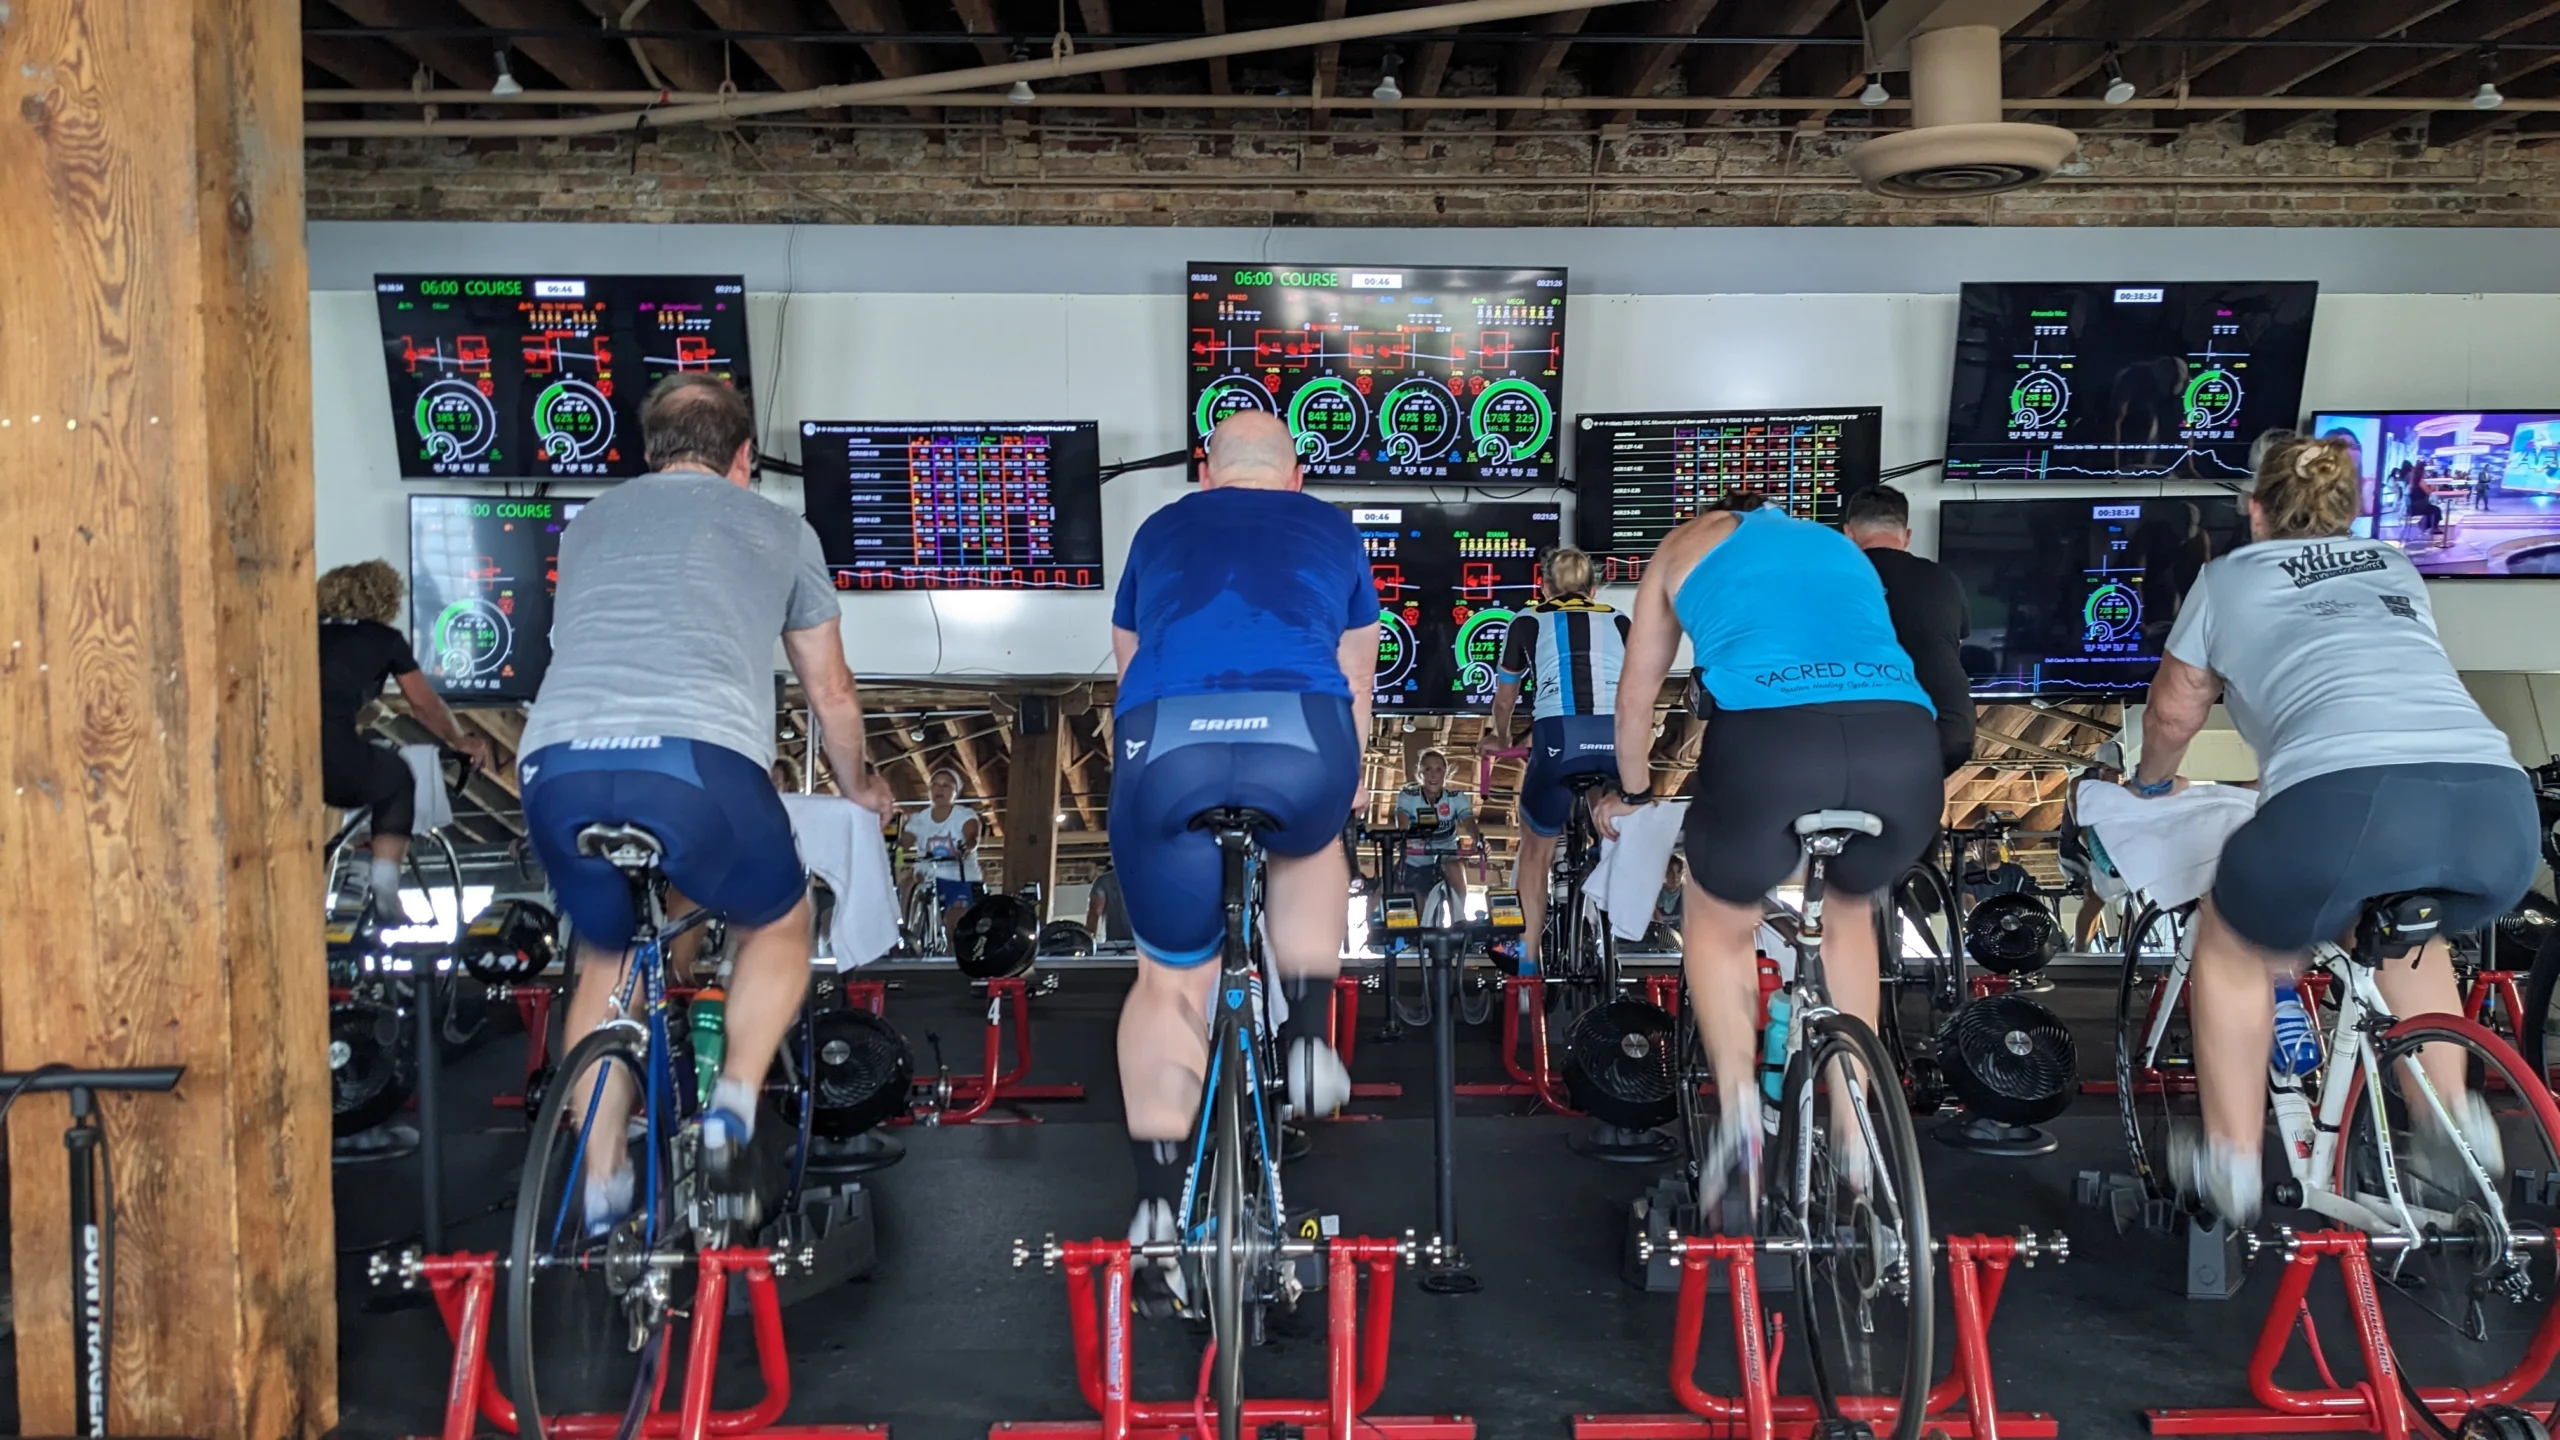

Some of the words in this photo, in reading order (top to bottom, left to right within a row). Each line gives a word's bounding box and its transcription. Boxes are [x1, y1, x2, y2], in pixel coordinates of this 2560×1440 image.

[1234, 271, 1274, 286] 06:00
[1279, 272, 1339, 287] COURSE
[1364, 277, 1390, 286] 00:46
[420, 280, 459, 296] 06:00
[464, 280, 523, 296] COURSE
[547, 285, 573, 293] 00:46
[2120, 292, 2158, 300] 00:38:34
[1307, 411, 1328, 422] 84%
[1332, 411, 1352, 422] 210
[1423, 412, 1437, 423] 92
[496, 503, 552, 518] COURSE
[2097, 509, 2136, 517] 00:38:34
[2301, 543, 2330, 558] All
[2278, 549, 2381, 581] Whites
[1379, 643, 1399, 653] 134
[1470, 641, 1495, 652] 127%
[1755, 662, 1846, 688] SACRED
[1189, 716, 1269, 732] SRAM
[569, 735, 663, 750] SRAM
[987, 996, 1001, 1026] 4
[83, 1222, 105, 1440] BONTRAGER
